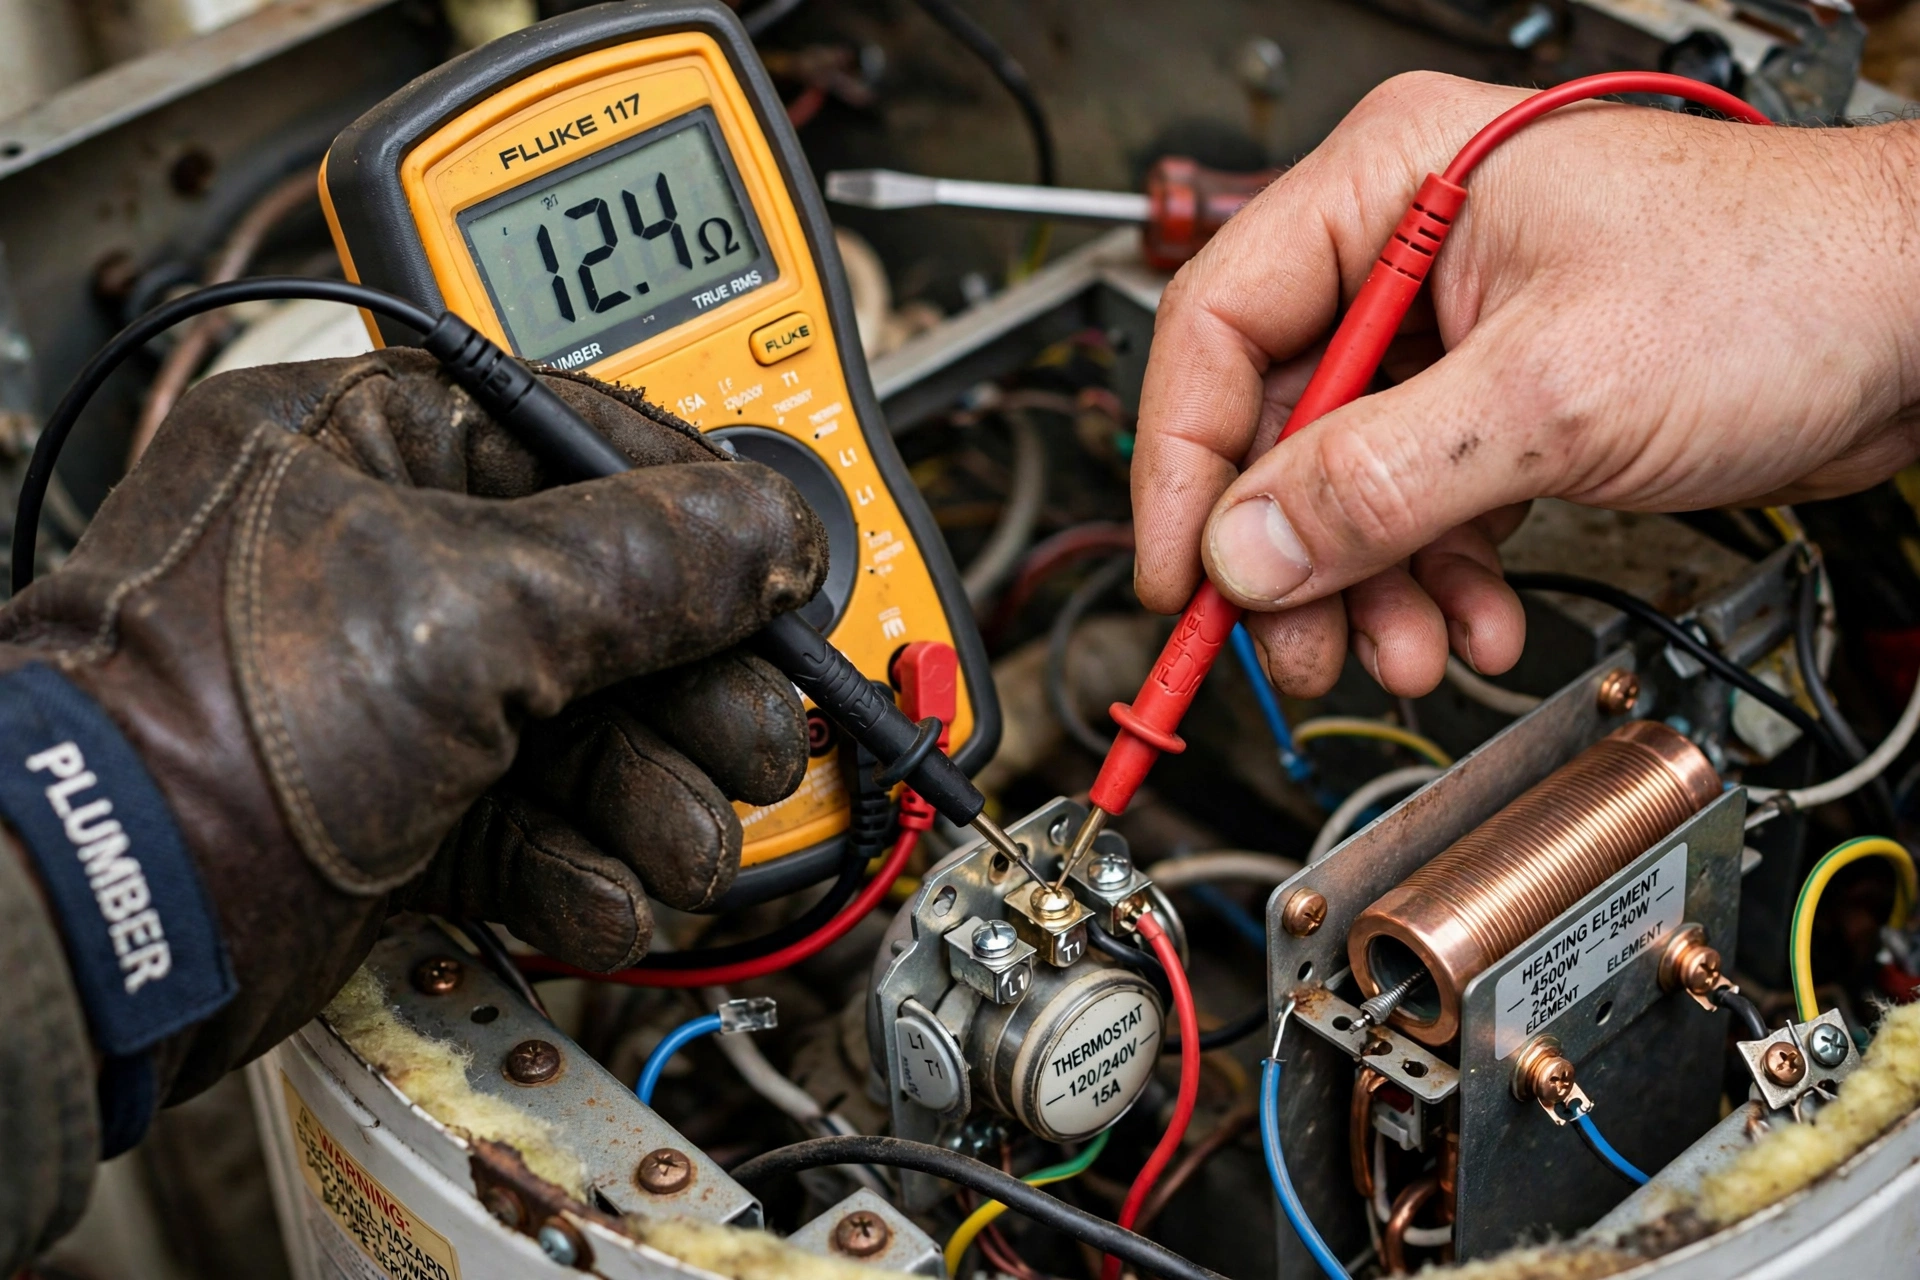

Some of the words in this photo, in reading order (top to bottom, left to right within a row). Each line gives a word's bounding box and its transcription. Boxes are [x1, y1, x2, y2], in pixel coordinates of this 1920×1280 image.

[498, 114, 598, 170] FLUKE
[603, 92, 640, 124] 117
[537, 172, 693, 323] 12.4
[698, 217, 741, 264] Ω
[691, 284, 730, 309] TRUE
[730, 269, 762, 293] RMS
[765, 325, 810, 353] FLUKE
[838, 448, 858, 467] L1
[26, 741, 173, 995] PLUMBER
[1062, 941, 1080, 962] T1
[1521, 922, 1588, 985] HEATING
[1592, 868, 1660, 933] ELEMENT
[1530, 948, 1580, 996] 4500W
[1609, 897, 1650, 940] 240W
[1607, 920, 1664, 973] ELEMENT
[1008, 974, 1025, 997] L1
[1526, 984, 1580, 1036] ELEMENT
[1531, 977, 1567, 1018] 240V
[907, 1032, 925, 1050] L1
[1052, 1003, 1142, 1077] THERMOSTAT
[924, 1059, 943, 1080] T1
[1068, 1037, 1137, 1098] 120/240V
[1092, 1078, 1122, 1107] 15A
[317, 1127, 413, 1237] WARNING:
